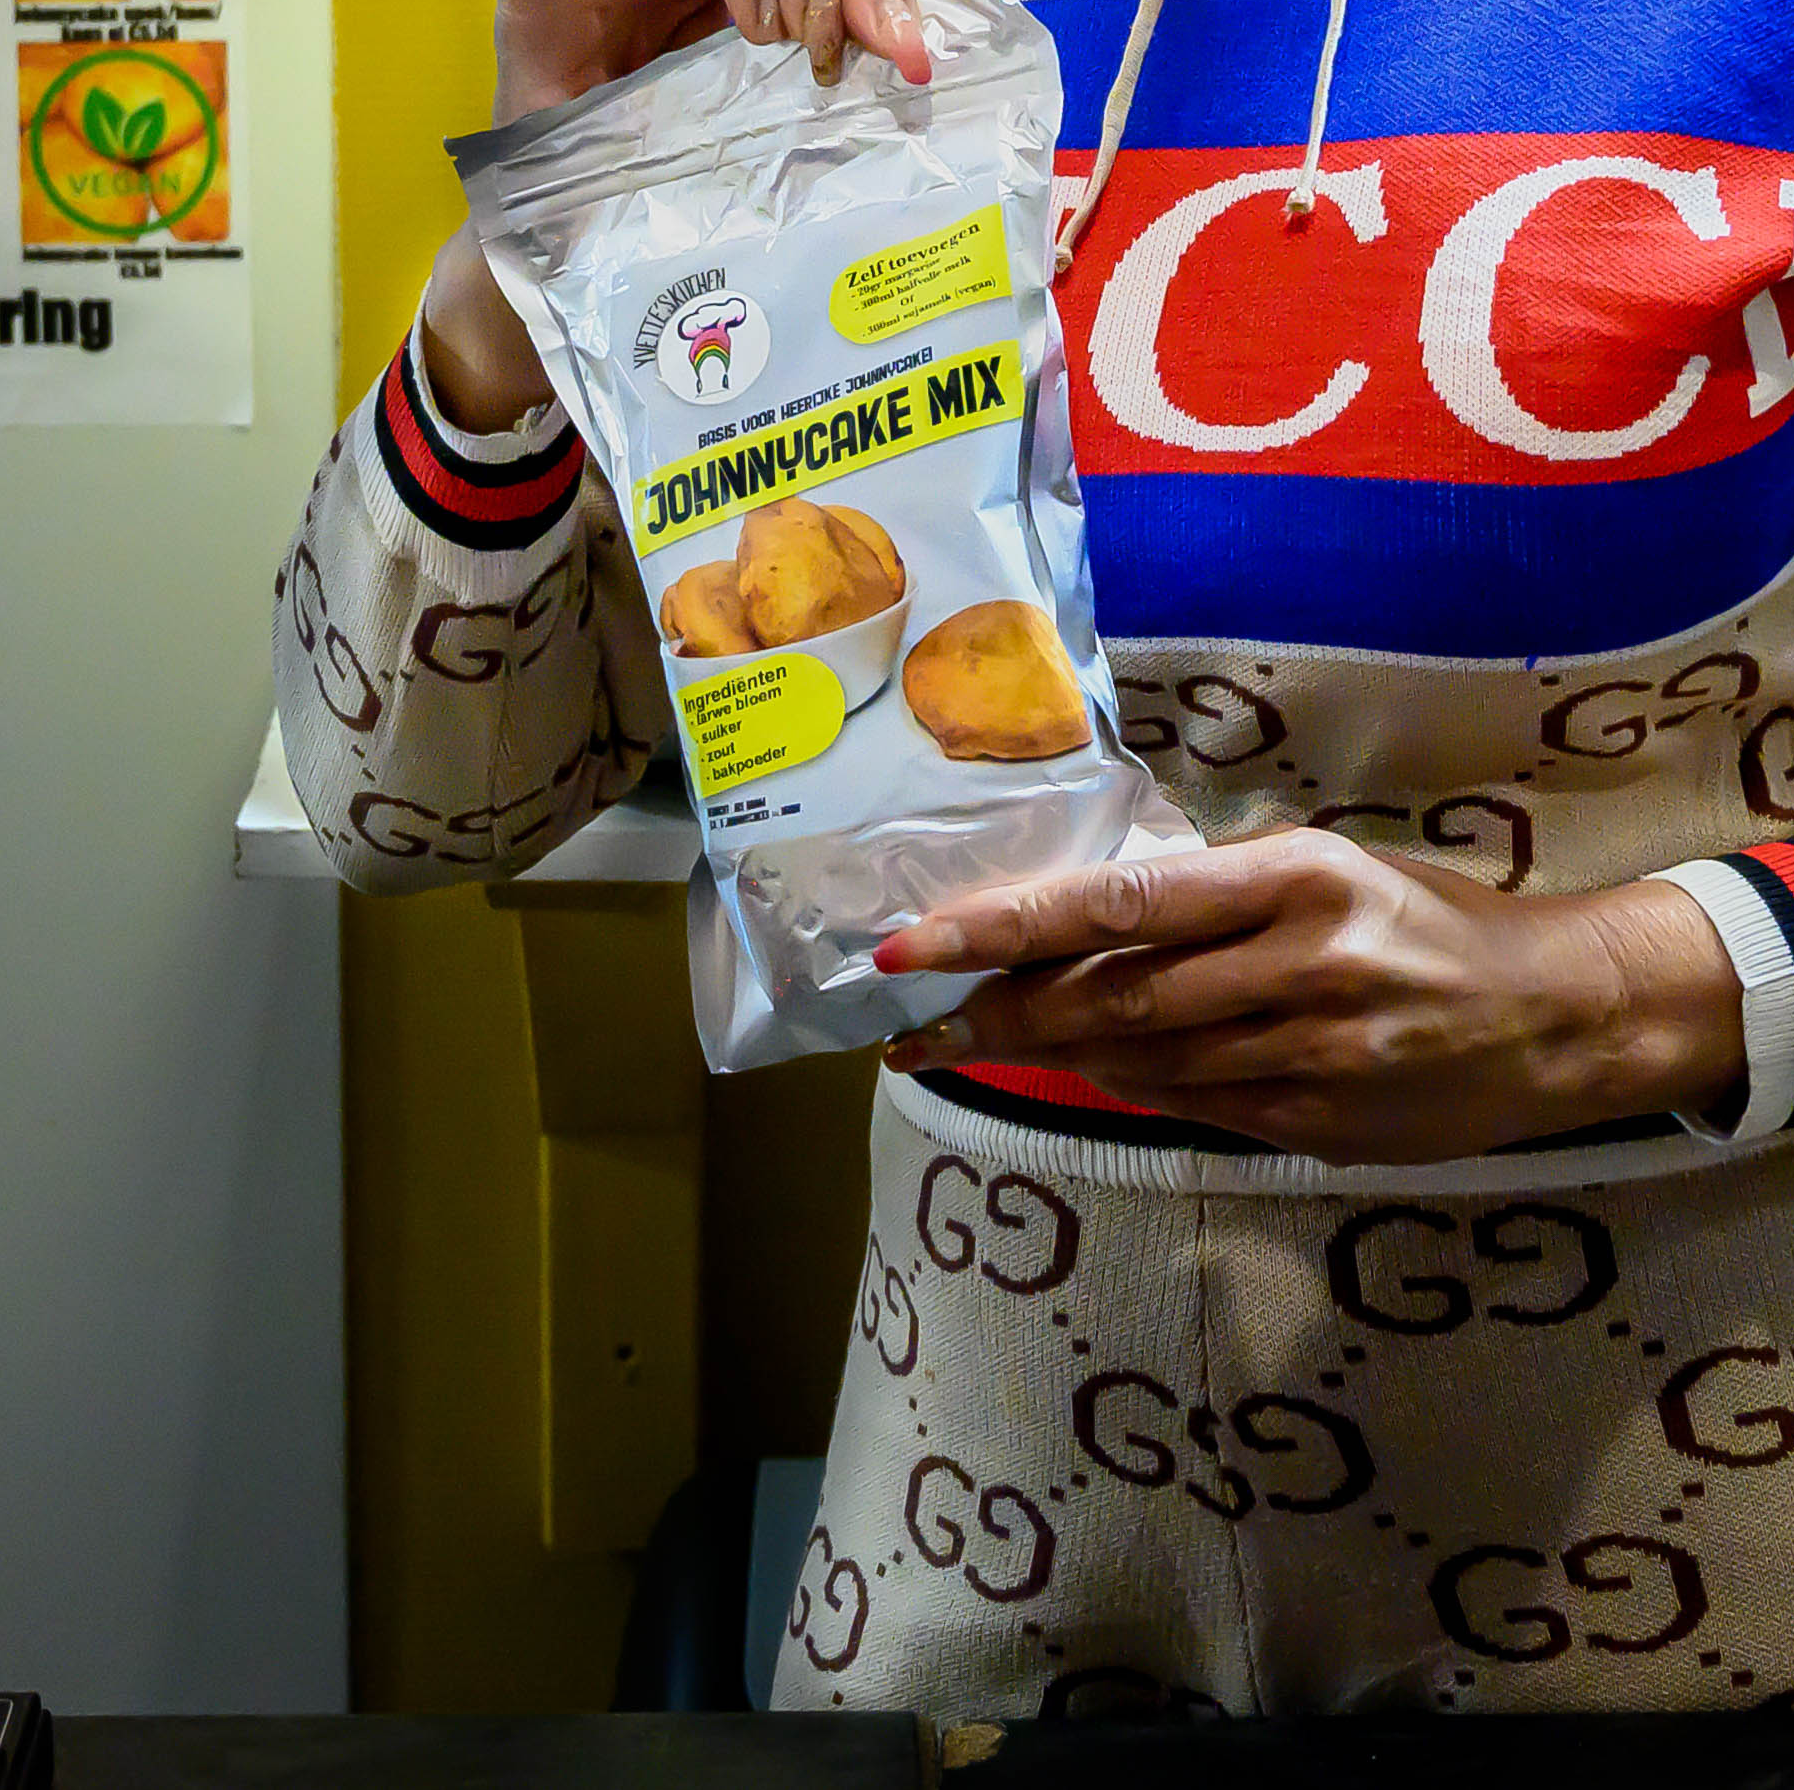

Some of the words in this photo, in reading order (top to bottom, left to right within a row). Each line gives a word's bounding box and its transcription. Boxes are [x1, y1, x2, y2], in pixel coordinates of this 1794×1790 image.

[68, 170, 183, 197] VEGAN
[845, 259, 885, 289] Zelf
[887, 222, 981, 272] toevoegen
[644, 385, 914, 537] JOHNNYCAKE
[926, 354, 1007, 428] MIX
[697, 421, 738, 450] BASIS
[741, 409, 777, 435] VOOR
[683, 665, 788, 715] Ingrediënten
[735, 685, 782, 712] bloem
[701, 719, 743, 744] suiker
[706, 741, 736, 763] zout
[711, 744, 788, 782] bakpoeder
